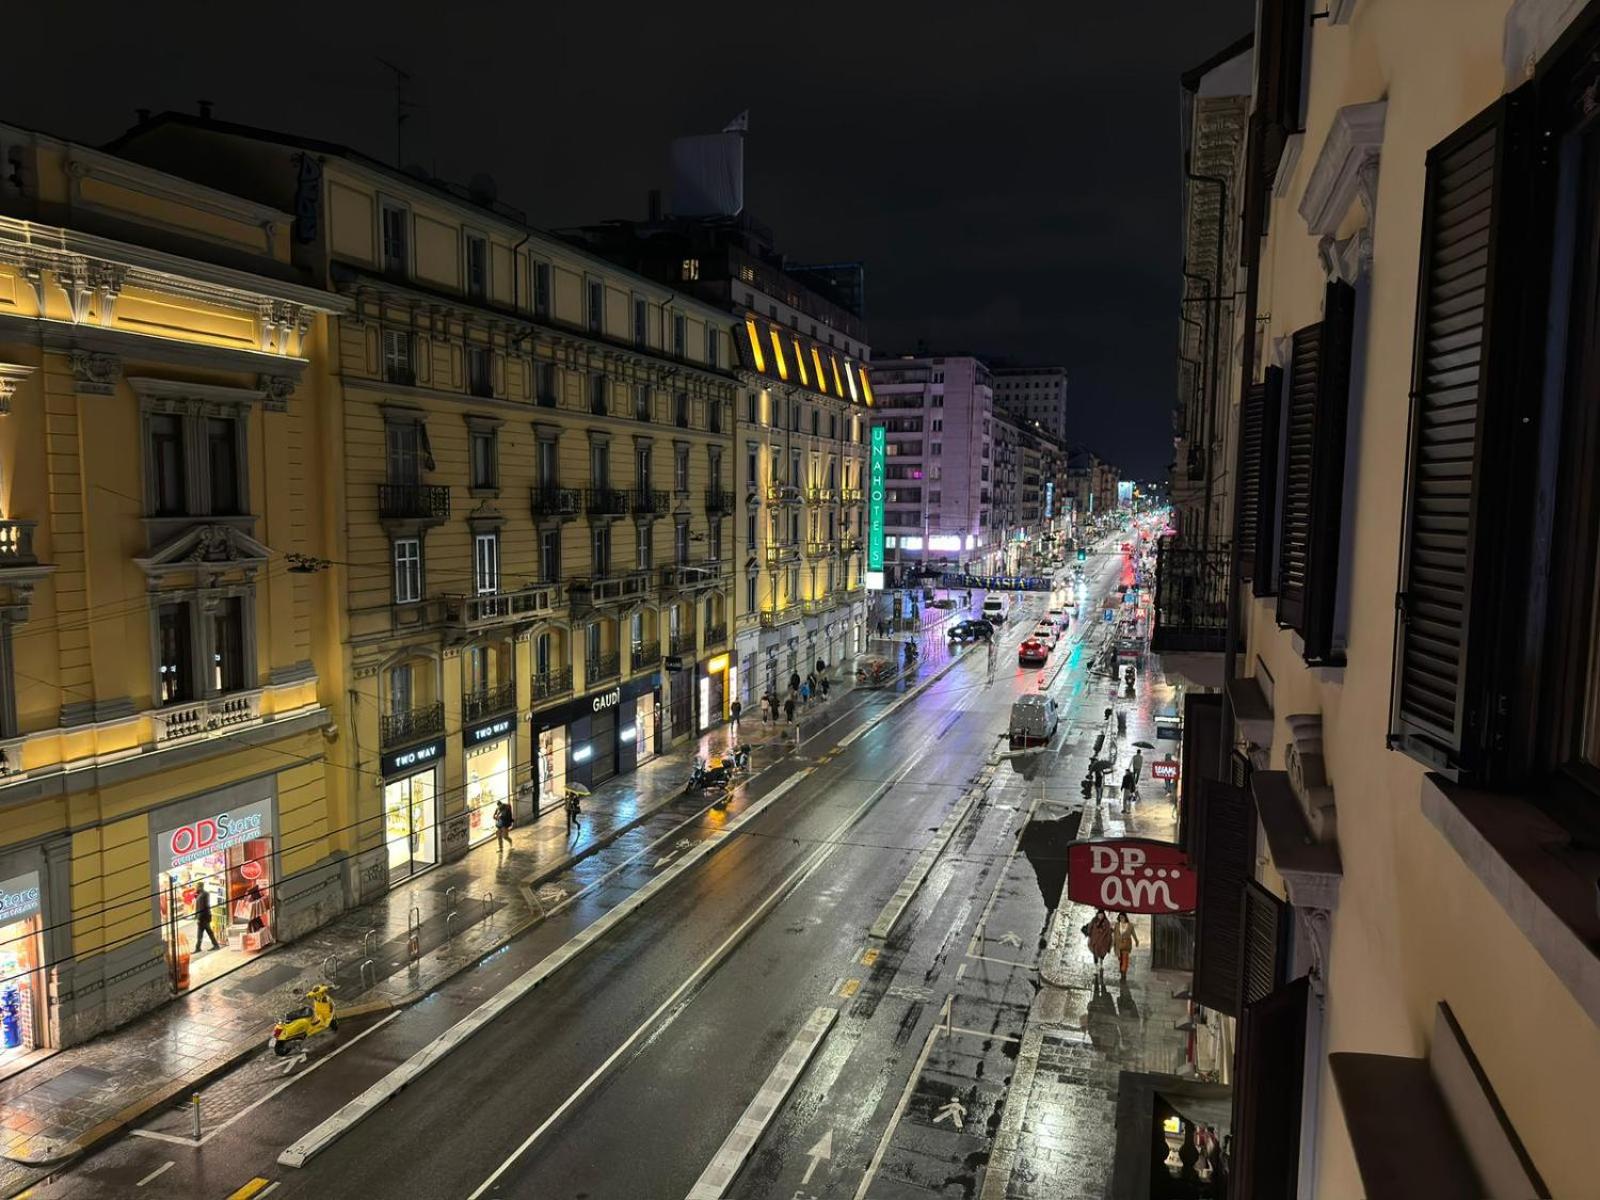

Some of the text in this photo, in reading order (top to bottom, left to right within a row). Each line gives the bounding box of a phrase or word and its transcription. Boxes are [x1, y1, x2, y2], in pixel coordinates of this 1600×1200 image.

[871, 430, 883, 561] UNAHOTELS
[475, 721, 509, 740] TWO WAY
[395, 746, 436, 767] TWO WAY
[171, 813, 262, 855] ODStore
[1101, 875, 1179, 910] am
